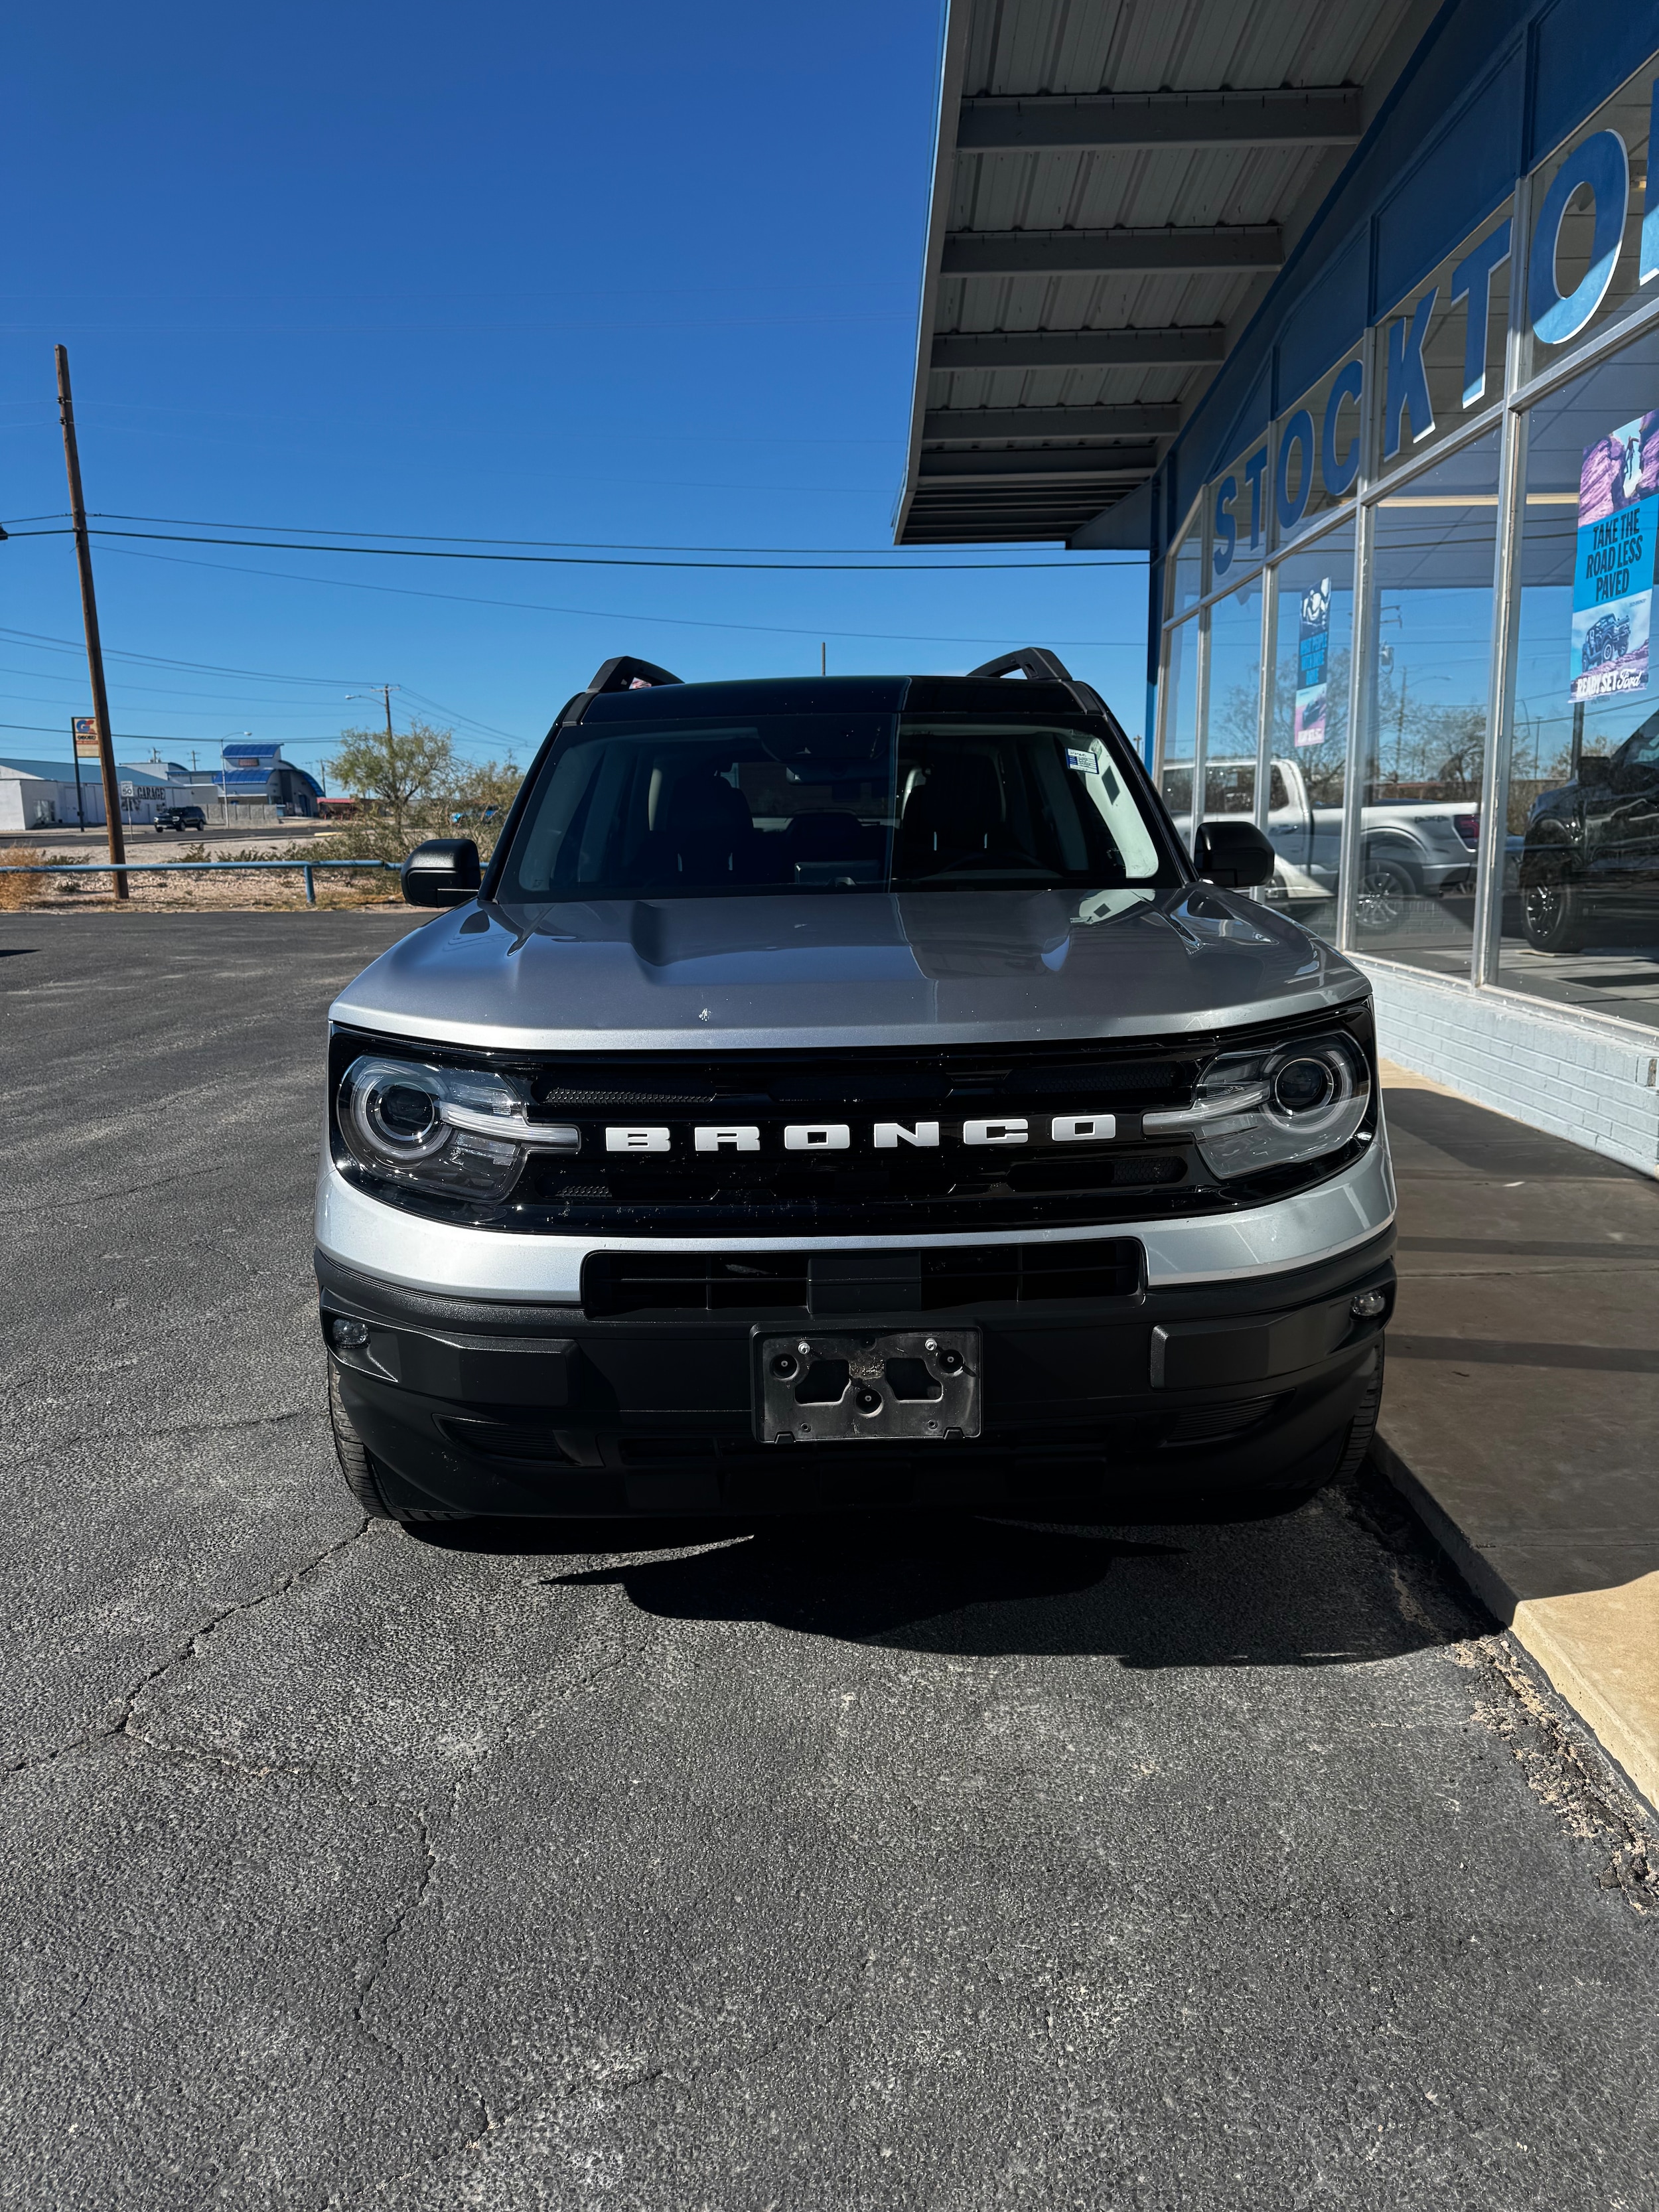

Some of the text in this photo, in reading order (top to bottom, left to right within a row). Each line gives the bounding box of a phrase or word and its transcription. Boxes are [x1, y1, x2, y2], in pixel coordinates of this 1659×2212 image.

[1213, 78, 1659, 576] STOCKTO
[1593, 507, 1640, 551] TAKE THE
[1586, 534, 1643, 579] ROAD LESS
[1595, 567, 1630, 602] PAVED
[1576, 668, 1645, 699] READY SET Ford
[137, 786, 166, 800] GARAGE
[605, 1114, 1117, 1153] BRONCO
